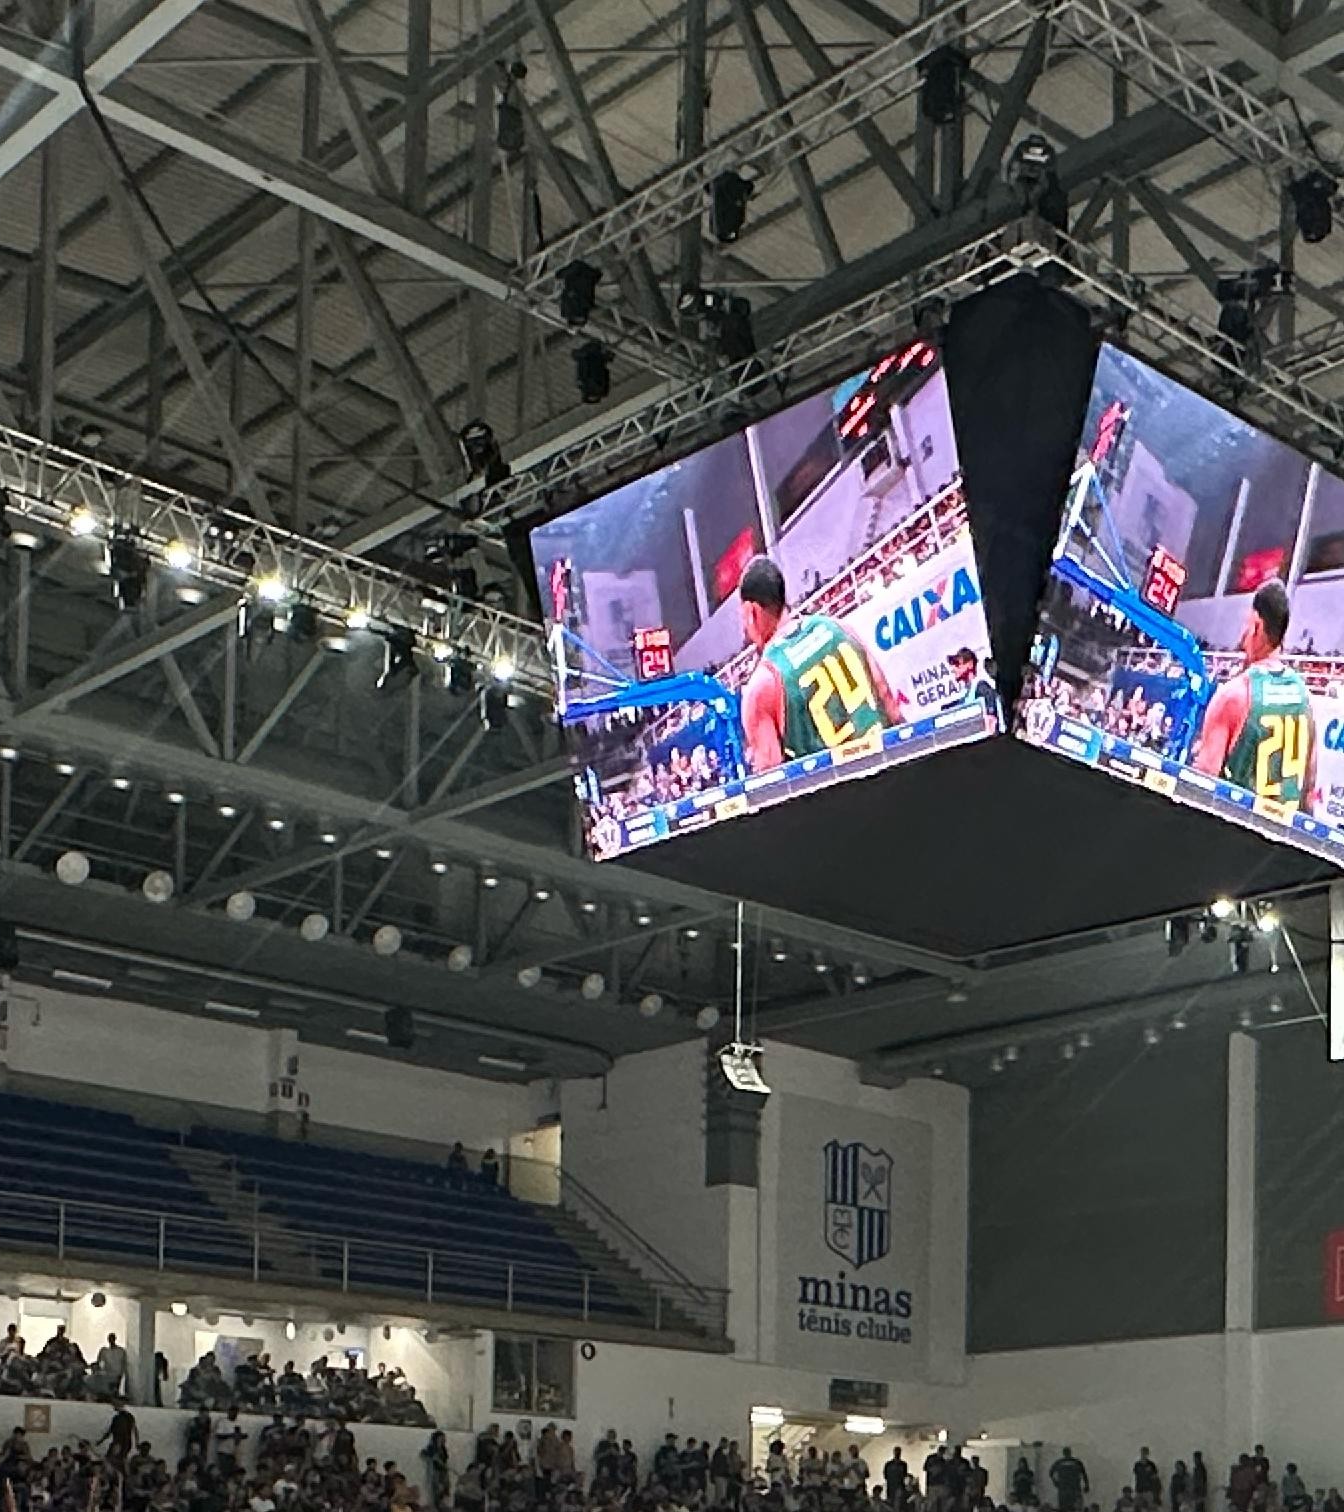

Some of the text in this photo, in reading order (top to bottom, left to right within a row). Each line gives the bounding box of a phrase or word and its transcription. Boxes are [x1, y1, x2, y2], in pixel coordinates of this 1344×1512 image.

[874, 568, 980, 651] CAIXA
[798, 641, 876, 748] 24
[1256, 714, 1308, 804] 24
[798, 1270, 912, 1318] minas
[798, 1309, 912, 1344] tênis clube
